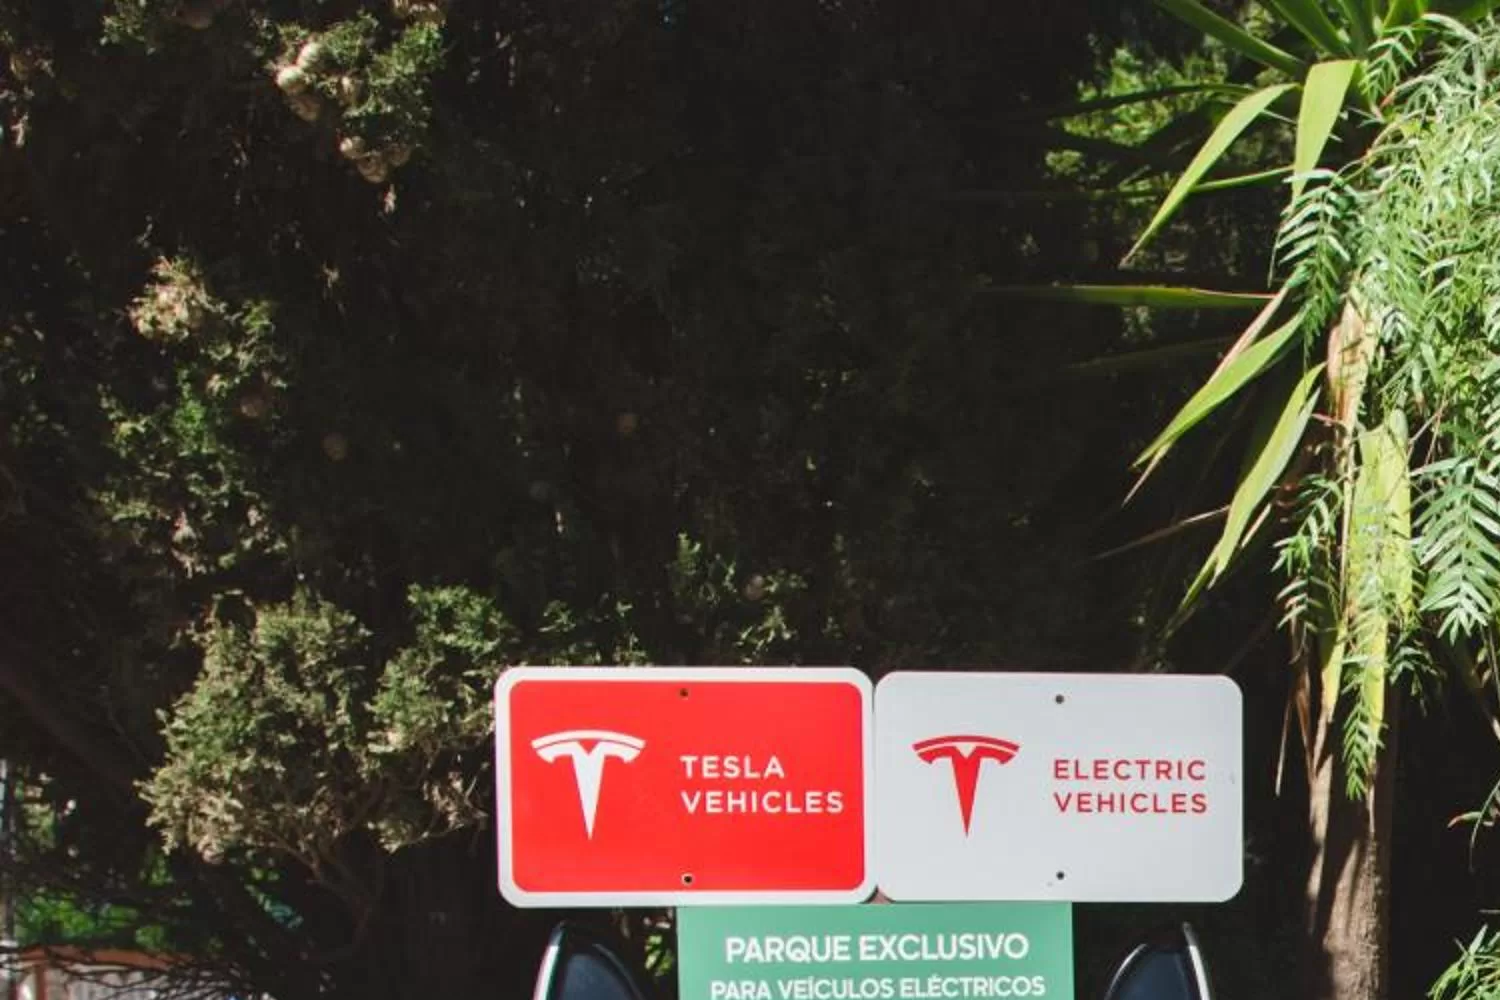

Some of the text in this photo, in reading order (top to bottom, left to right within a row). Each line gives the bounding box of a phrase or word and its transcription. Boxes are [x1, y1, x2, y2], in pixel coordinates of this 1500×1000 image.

[679, 755, 785, 779] TESLA
[1053, 758, 1206, 782] ELECTRIC
[681, 790, 844, 814] VEHICLES
[1053, 791, 1208, 814] VEHICLES
[725, 932, 1030, 963] PARQUE EXCLUSIVO
[777, 975, 895, 1000] VEÍCULOS
[899, 973, 1046, 999] ELÉCTRICOS
